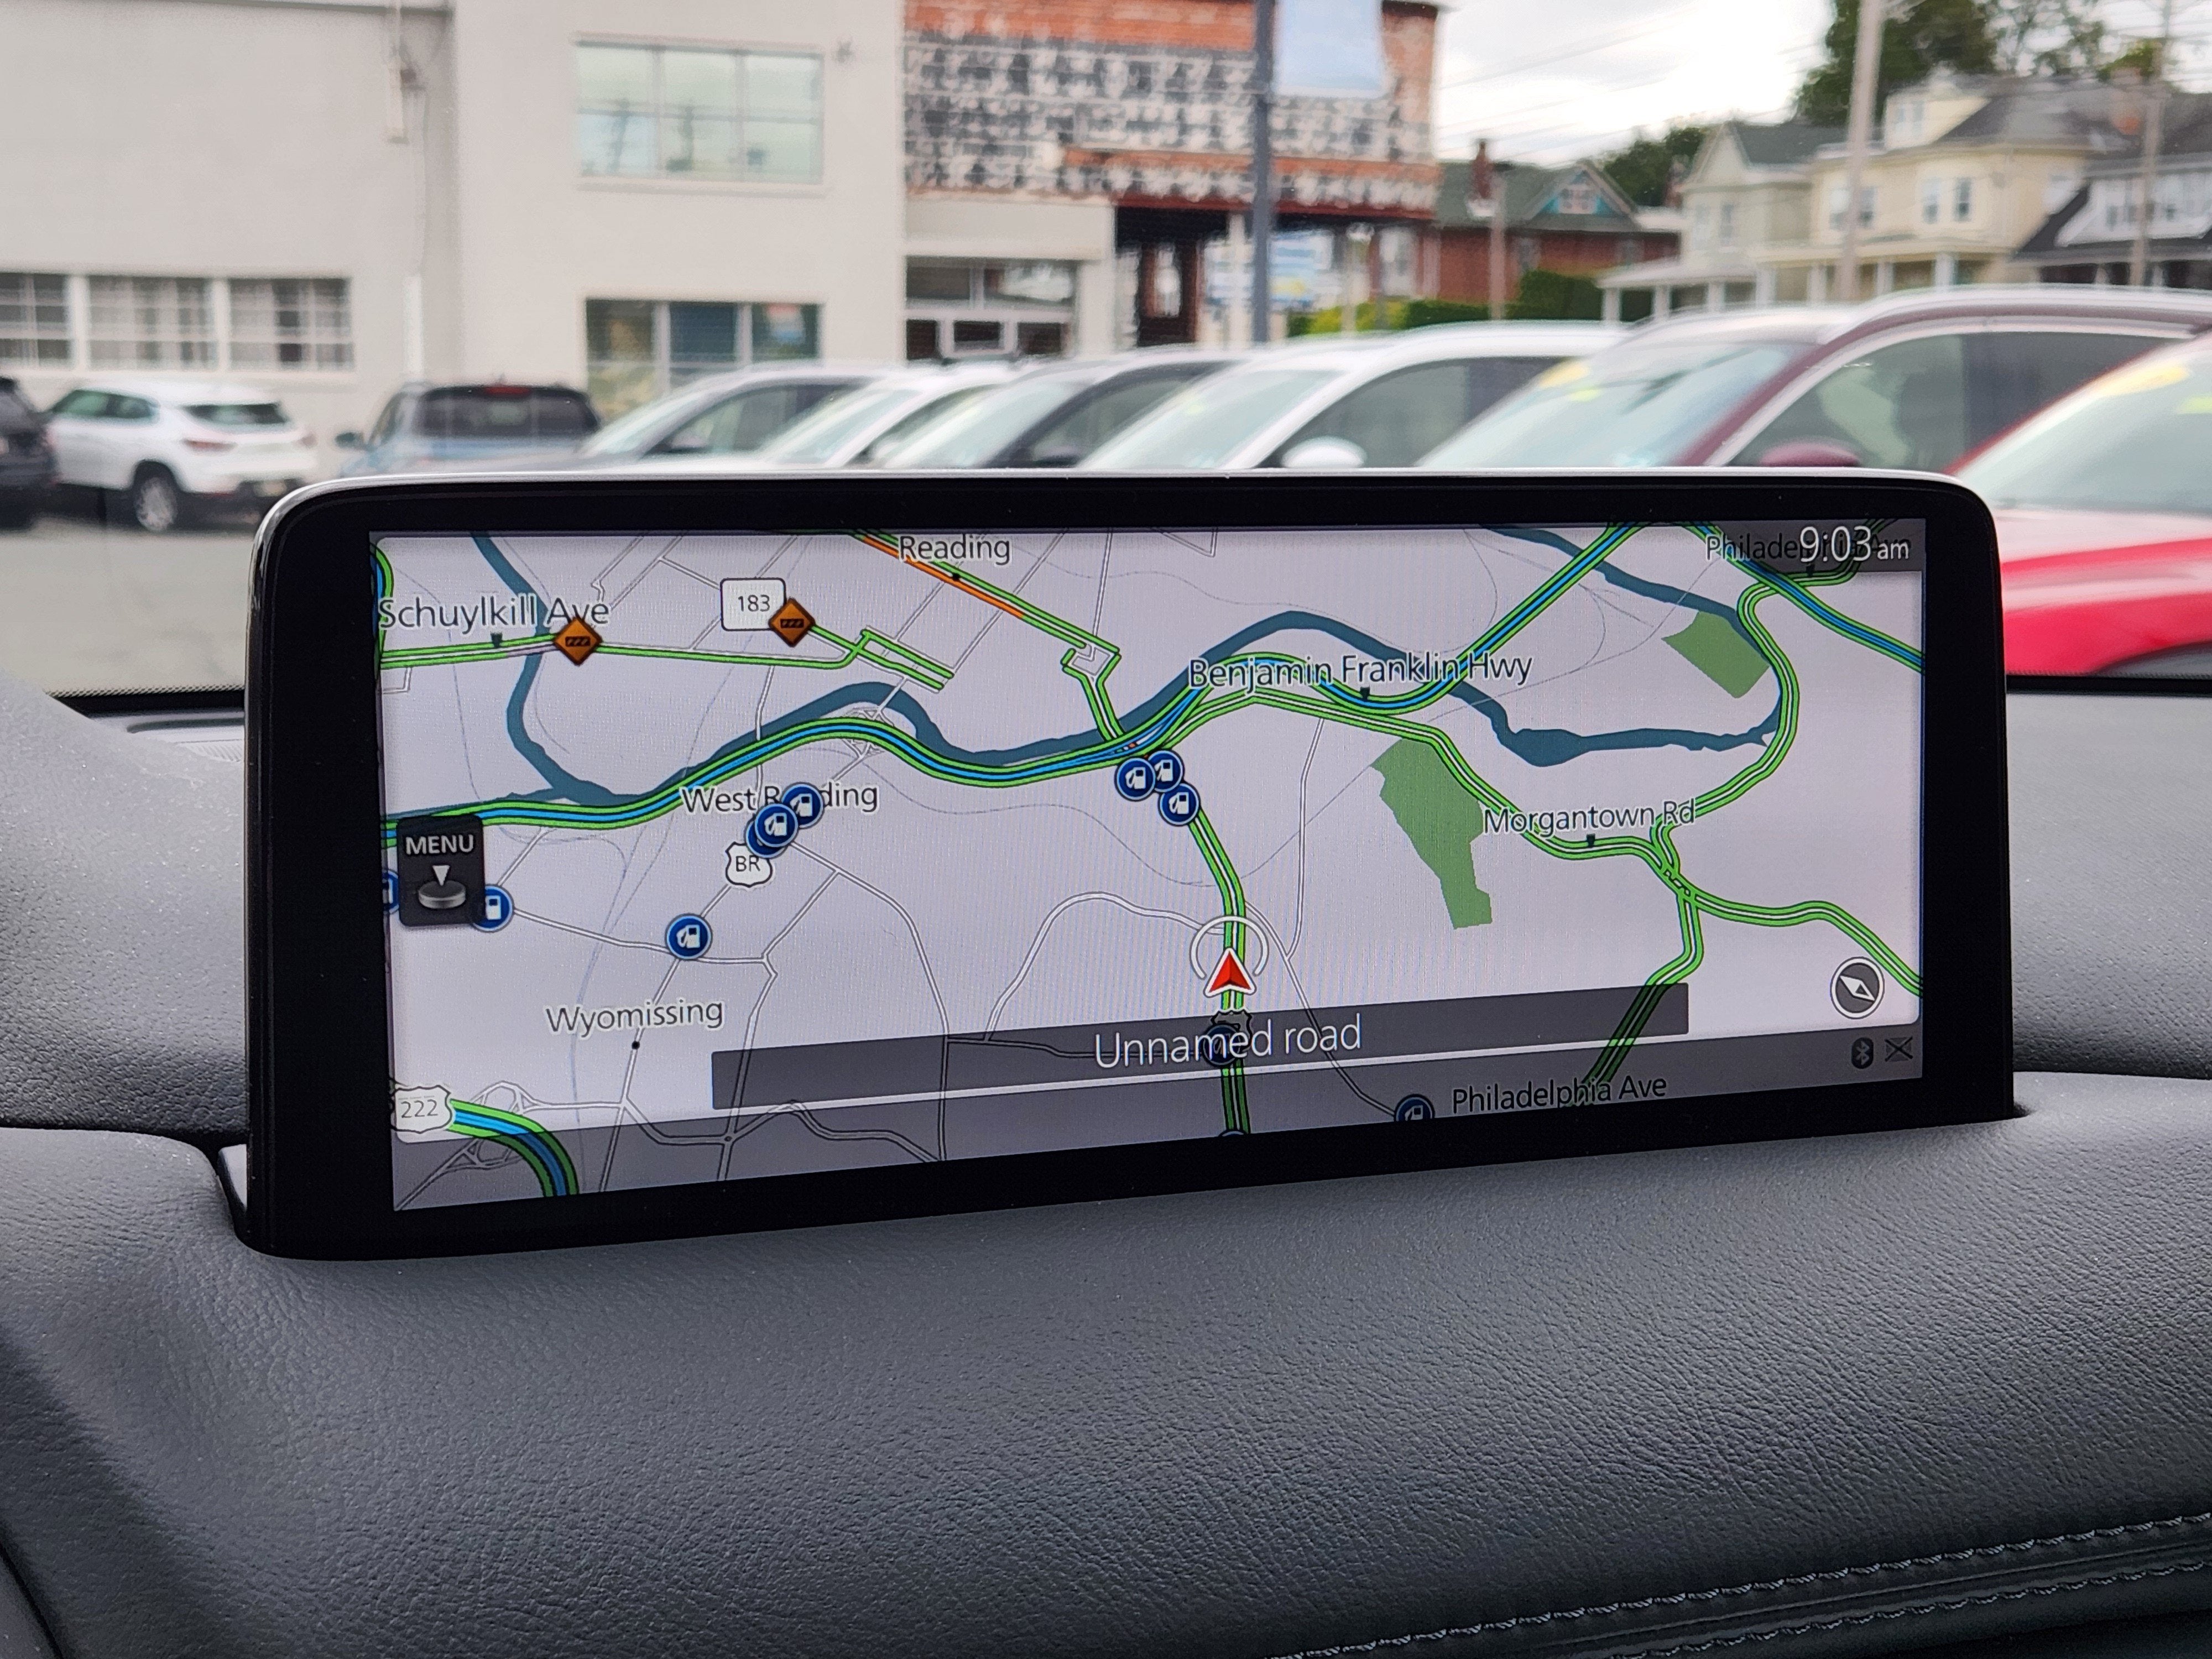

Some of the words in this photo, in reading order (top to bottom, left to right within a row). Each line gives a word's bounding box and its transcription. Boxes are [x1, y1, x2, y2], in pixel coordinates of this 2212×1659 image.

[900, 533, 1010, 565] Reading
[1800, 526, 1871, 562] 9:03
[1877, 541, 1909, 560] am
[379, 594, 536, 635] Schuylkill
[547, 597, 608, 624] Ave
[738, 594, 770, 612] 183
[1190, 656, 1332, 693] Benjamin
[1342, 652, 1459, 684] Franklin
[1469, 654, 1532, 685] Hwy
[682, 786, 756, 812] West
[765, 782, 878, 813] Rding
[1485, 806, 1654, 837] Morgantown
[1663, 799, 1694, 825] Rd
[405, 834, 474, 854] MENU
[735, 855, 760, 872] BR
[546, 999, 722, 1037] Wyomissing
[1095, 1019, 1272, 1068] Unnamed
[1286, 1013, 1361, 1054] road
[401, 1099, 438, 1118] 222
[1453, 1078, 1611, 1113] Philadelphia
[1618, 1075, 1667, 1100] Ave
